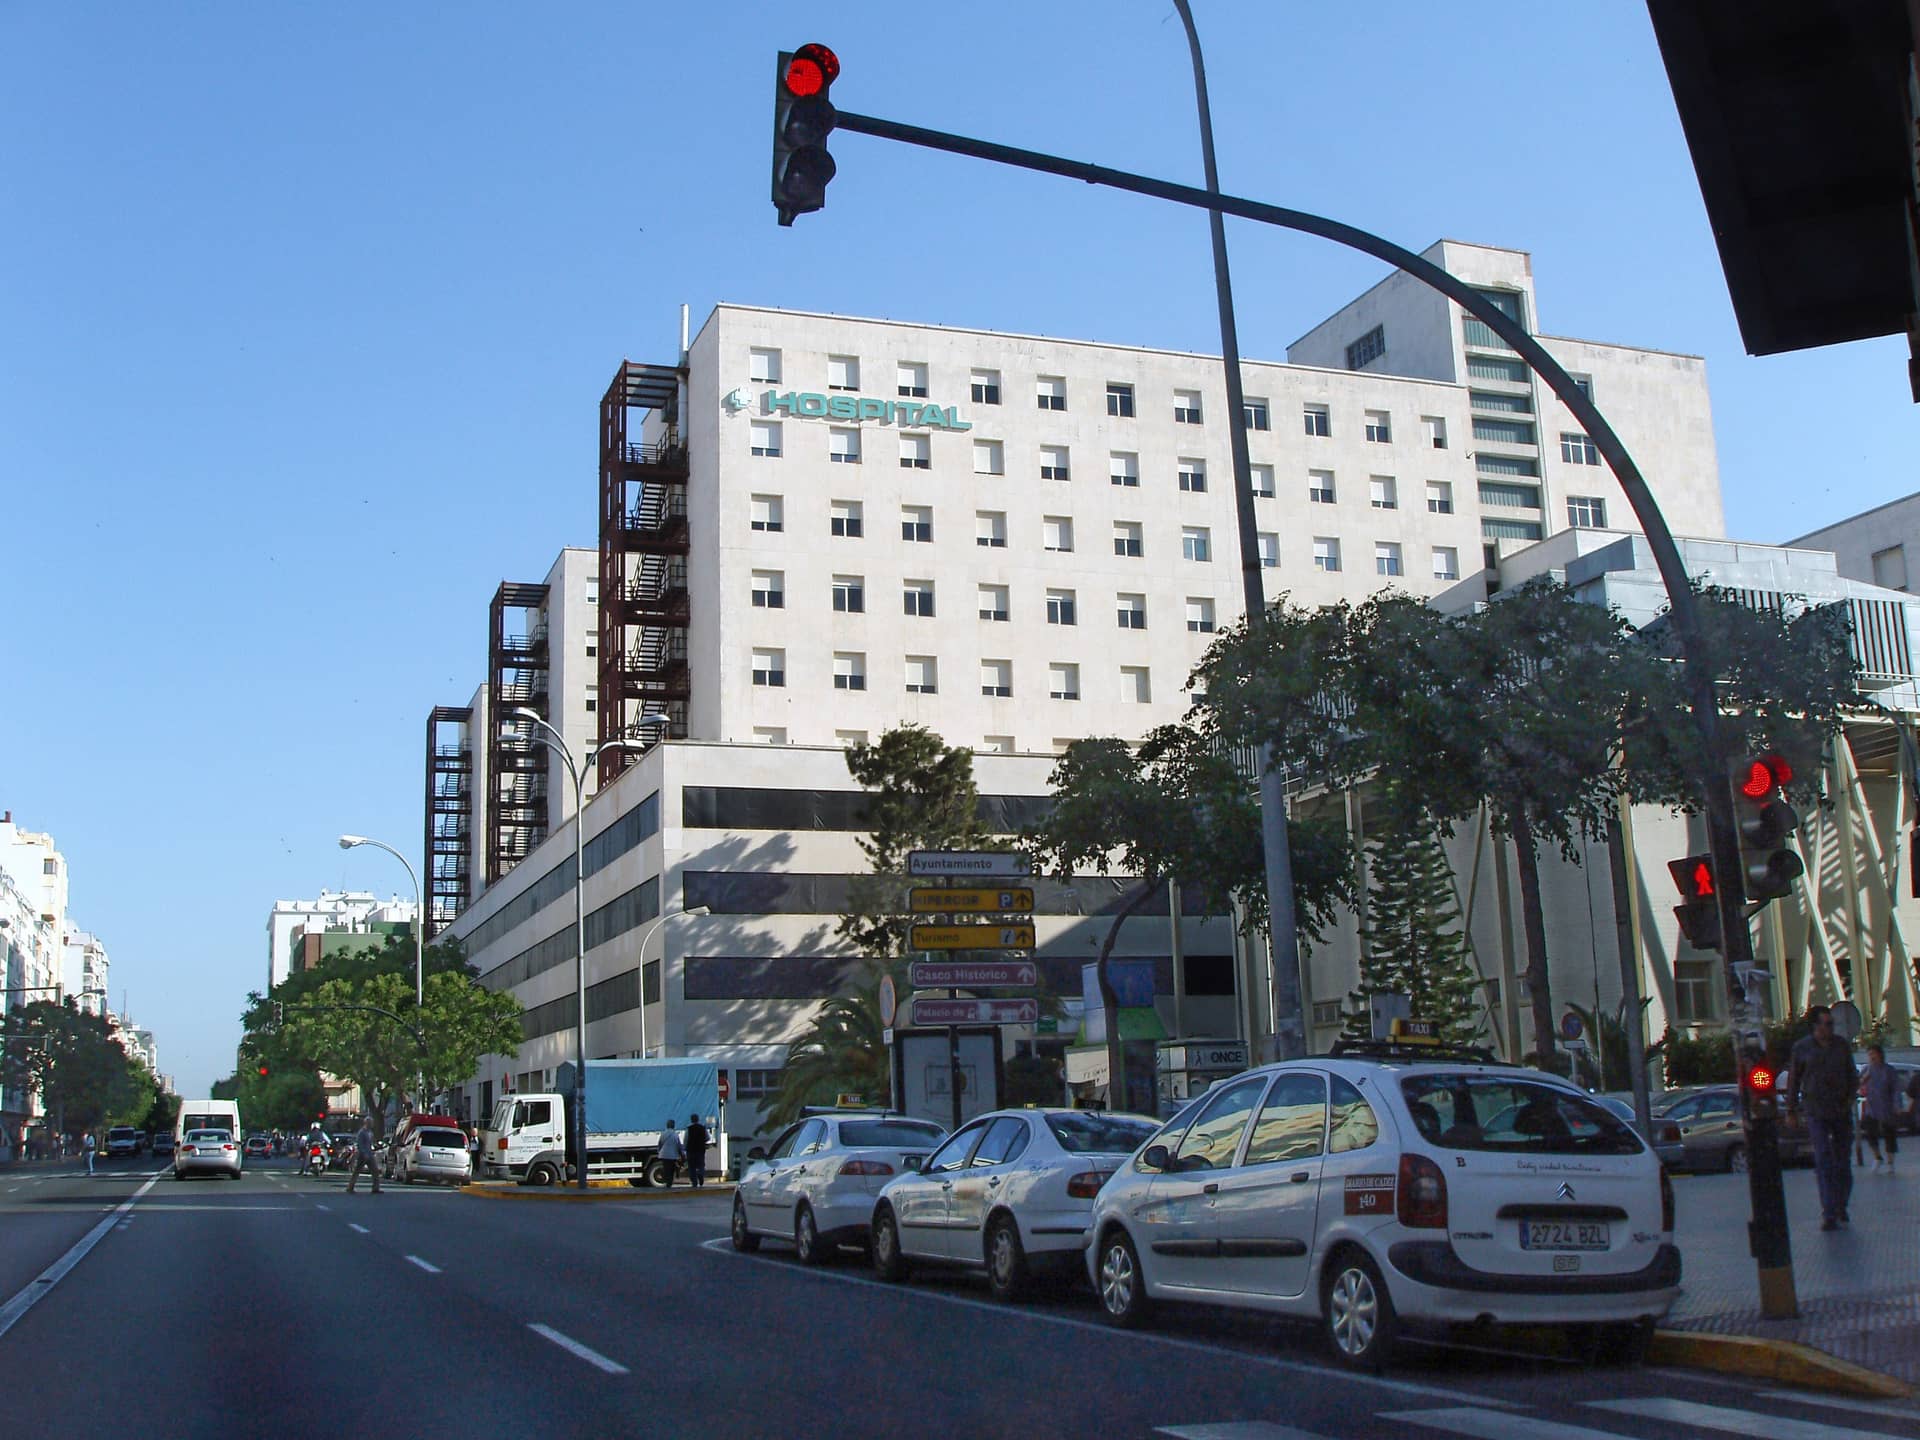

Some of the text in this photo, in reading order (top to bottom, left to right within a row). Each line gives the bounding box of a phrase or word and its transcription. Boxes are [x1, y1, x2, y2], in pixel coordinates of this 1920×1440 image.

[764, 389, 973, 431] HOSPITAL
[912, 857, 993, 871] Ayuntamiento
[1001, 894, 1011, 907] P
[915, 932, 960, 943] Turismo
[916, 969, 950, 980] Casco
[1409, 1023, 1430, 1034] TAXI
[1211, 1050, 1243, 1063] ONCE
[1455, 1157, 1466, 1168] B
[1531, 1225, 1607, 1244] 2724 BZL
